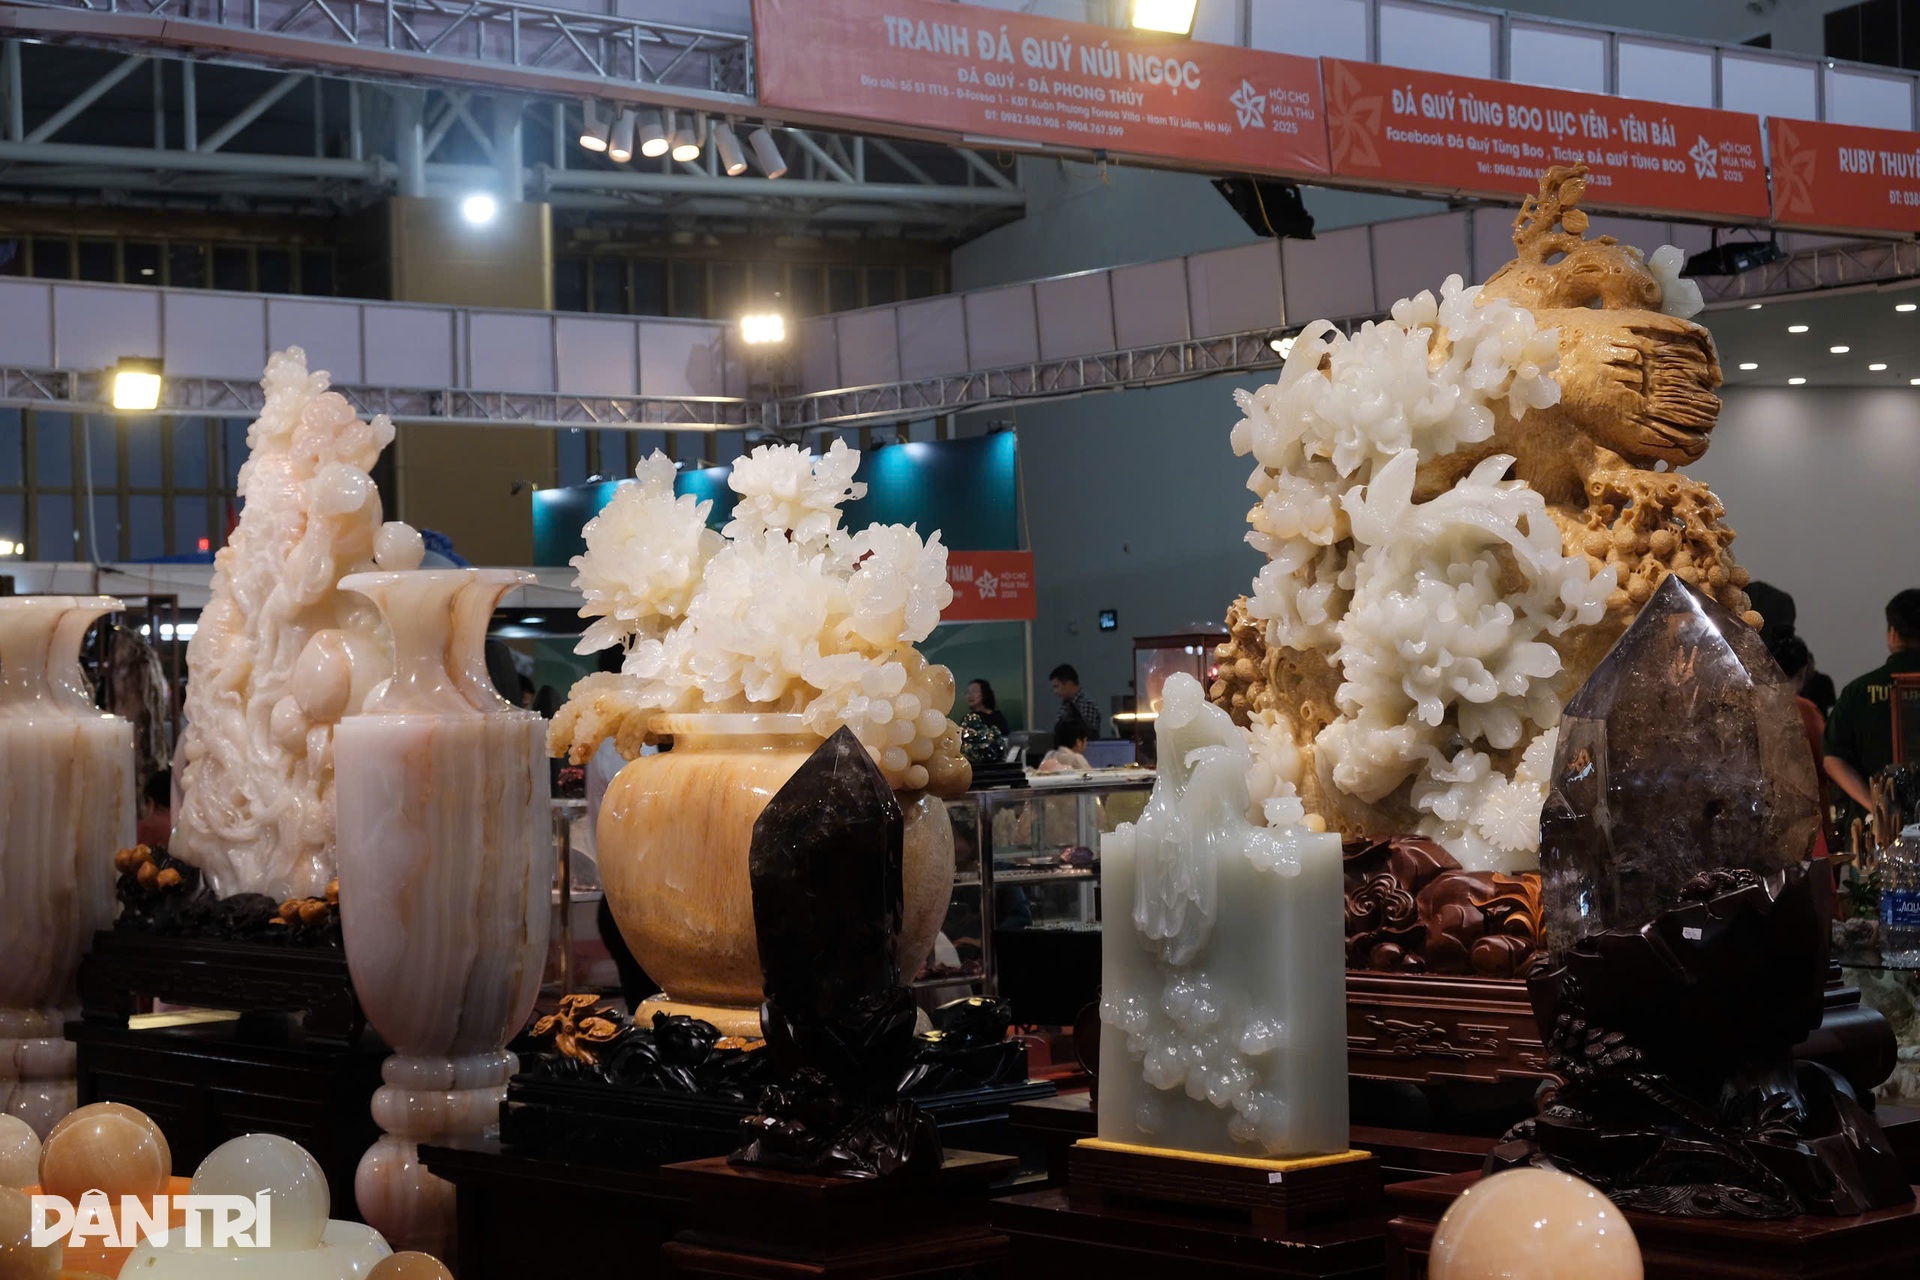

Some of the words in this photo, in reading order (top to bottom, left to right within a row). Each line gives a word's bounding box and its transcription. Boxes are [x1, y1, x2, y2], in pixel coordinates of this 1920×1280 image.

[884, 15, 970, 57] TRANH
[978, 24, 1015, 64] ĐÁ
[1021, 34, 1072, 72] QUÝ
[1081, 40, 1121, 79] NÚI
[1128, 52, 1200, 95] NGỌC
[957, 66, 980, 84] ĐÁ
[984, 71, 1015, 88] QUÝ
[1028, 75, 1049, 94] ĐÁ
[1053, 82, 1106, 102] PHONG
[1109, 86, 1144, 106] THỦY
[1147, 113, 1167, 126] Nam
[1295, 106, 1315, 120] THU
[1391, 84, 1417, 116] ĐÁ
[1421, 90, 1455, 121] QUÝ
[1459, 92, 1503, 127] TÙNG
[1507, 104, 1542, 131] BOO
[1547, 108, 1577, 141] LỤC
[1579, 108, 1608, 140] YÊN
[1619, 113, 1648, 145] YÊN
[1652, 117, 1677, 147] BÁI
[1272, 119, 1298, 134] 2025
[1386, 126, 1445, 147] Facebook
[1447, 133, 1464, 149] Đá
[1467, 136, 1490, 155] Quý
[1492, 138, 1520, 159] Tùng
[1522, 142, 1544, 158] Boo
[1587, 147, 1604, 165] ĐÁ
[1606, 150, 1629, 168] QUÝ
[1632, 152, 1660, 171] TÙNG
[1662, 158, 1686, 174] BOO
[1838, 146, 1876, 175] RUBY
[1723, 170, 1744, 182] 2025
[952, 565, 974, 582] NAM
[1867, 684, 1889, 704] TU
[1901, 901, 1920, 914] AQU
